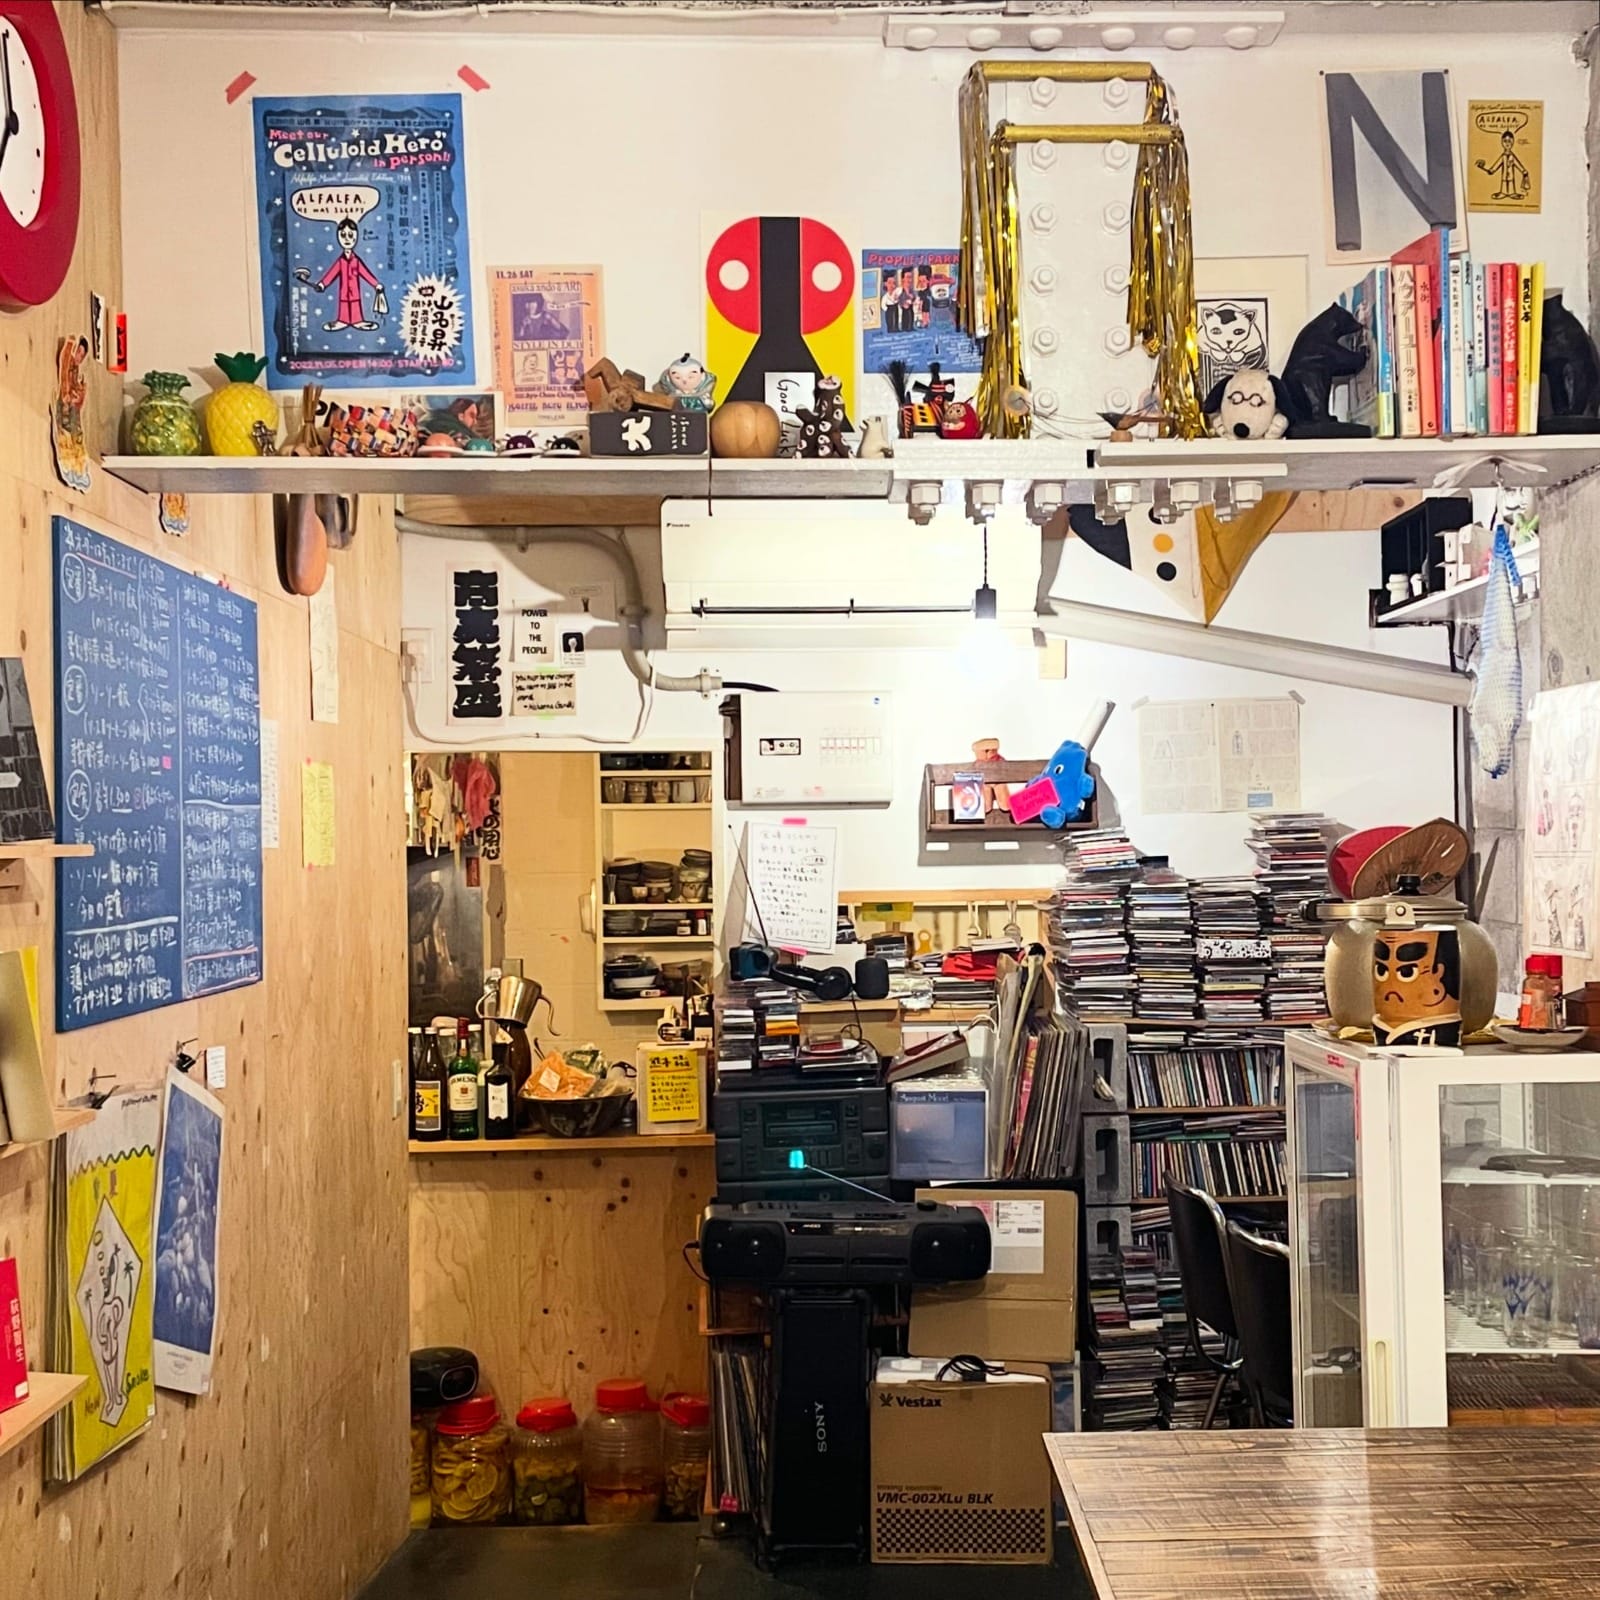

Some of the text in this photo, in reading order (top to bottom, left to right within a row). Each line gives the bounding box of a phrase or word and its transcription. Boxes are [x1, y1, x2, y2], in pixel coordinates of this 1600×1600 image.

[269, 129, 305, 140] Meet
[374, 158, 386, 167] in
[1325, 72, 1456, 250] N
[519, 270, 533, 278] SAT
[777, 379, 800, 415] Good
[777, 421, 801, 454] Luck
[521, 609, 548, 617] POWER
[531, 622, 540, 630] TO
[529, 634, 542, 642] THE
[522, 646, 548, 655] PEOPLE
[896, 1396, 942, 1408] Vestax
[814, 1401, 828, 1453] SONY
[877, 1492, 994, 1504] VMC-002XLu BLK
